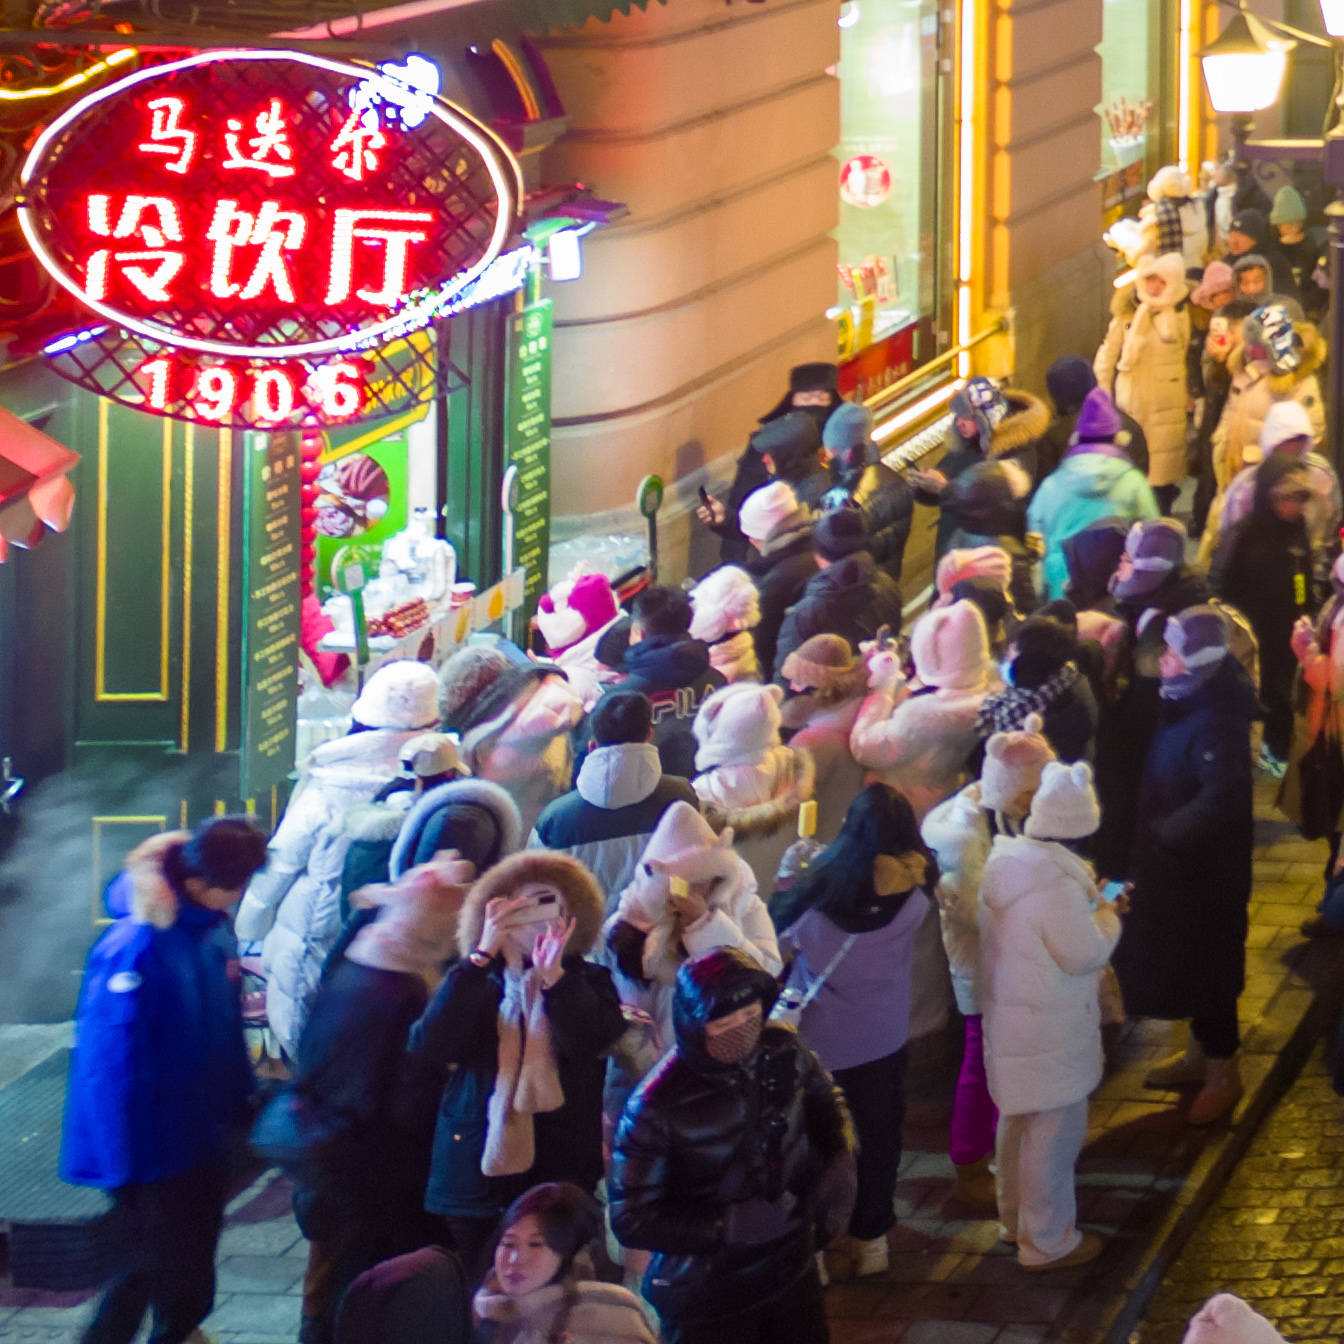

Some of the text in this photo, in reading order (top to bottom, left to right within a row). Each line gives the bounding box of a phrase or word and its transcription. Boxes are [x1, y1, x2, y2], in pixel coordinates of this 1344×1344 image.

[138, 96, 389, 181] 马迭尔
[84, 193, 434, 306] 冷饮厅
[141, 358, 364, 422] 1906
